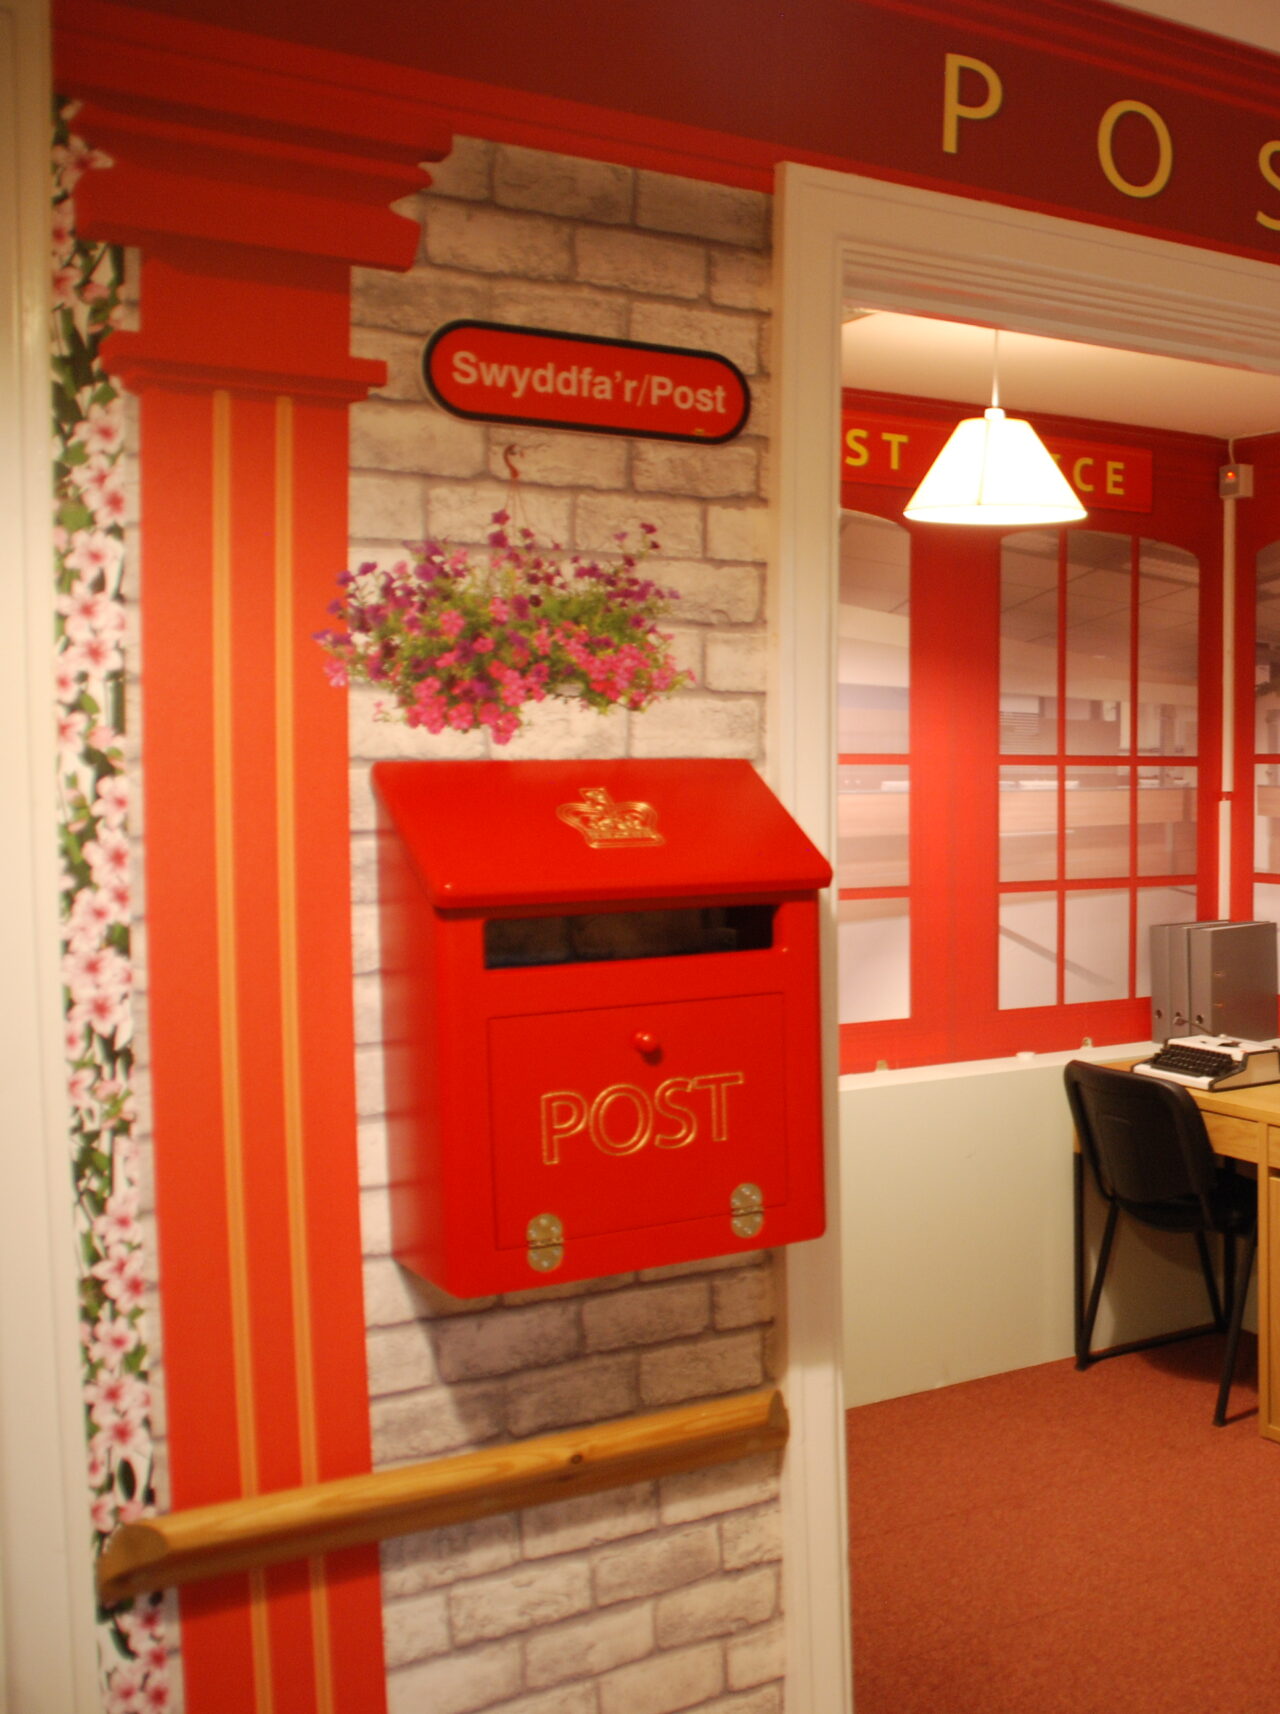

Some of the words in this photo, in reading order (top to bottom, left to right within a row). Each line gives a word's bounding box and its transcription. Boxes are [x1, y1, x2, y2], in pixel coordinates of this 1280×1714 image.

[452, 350, 727, 414] Swyddfa'r/Post
[845, 428, 909, 470] ST
[540, 1072, 743, 1164] POST
